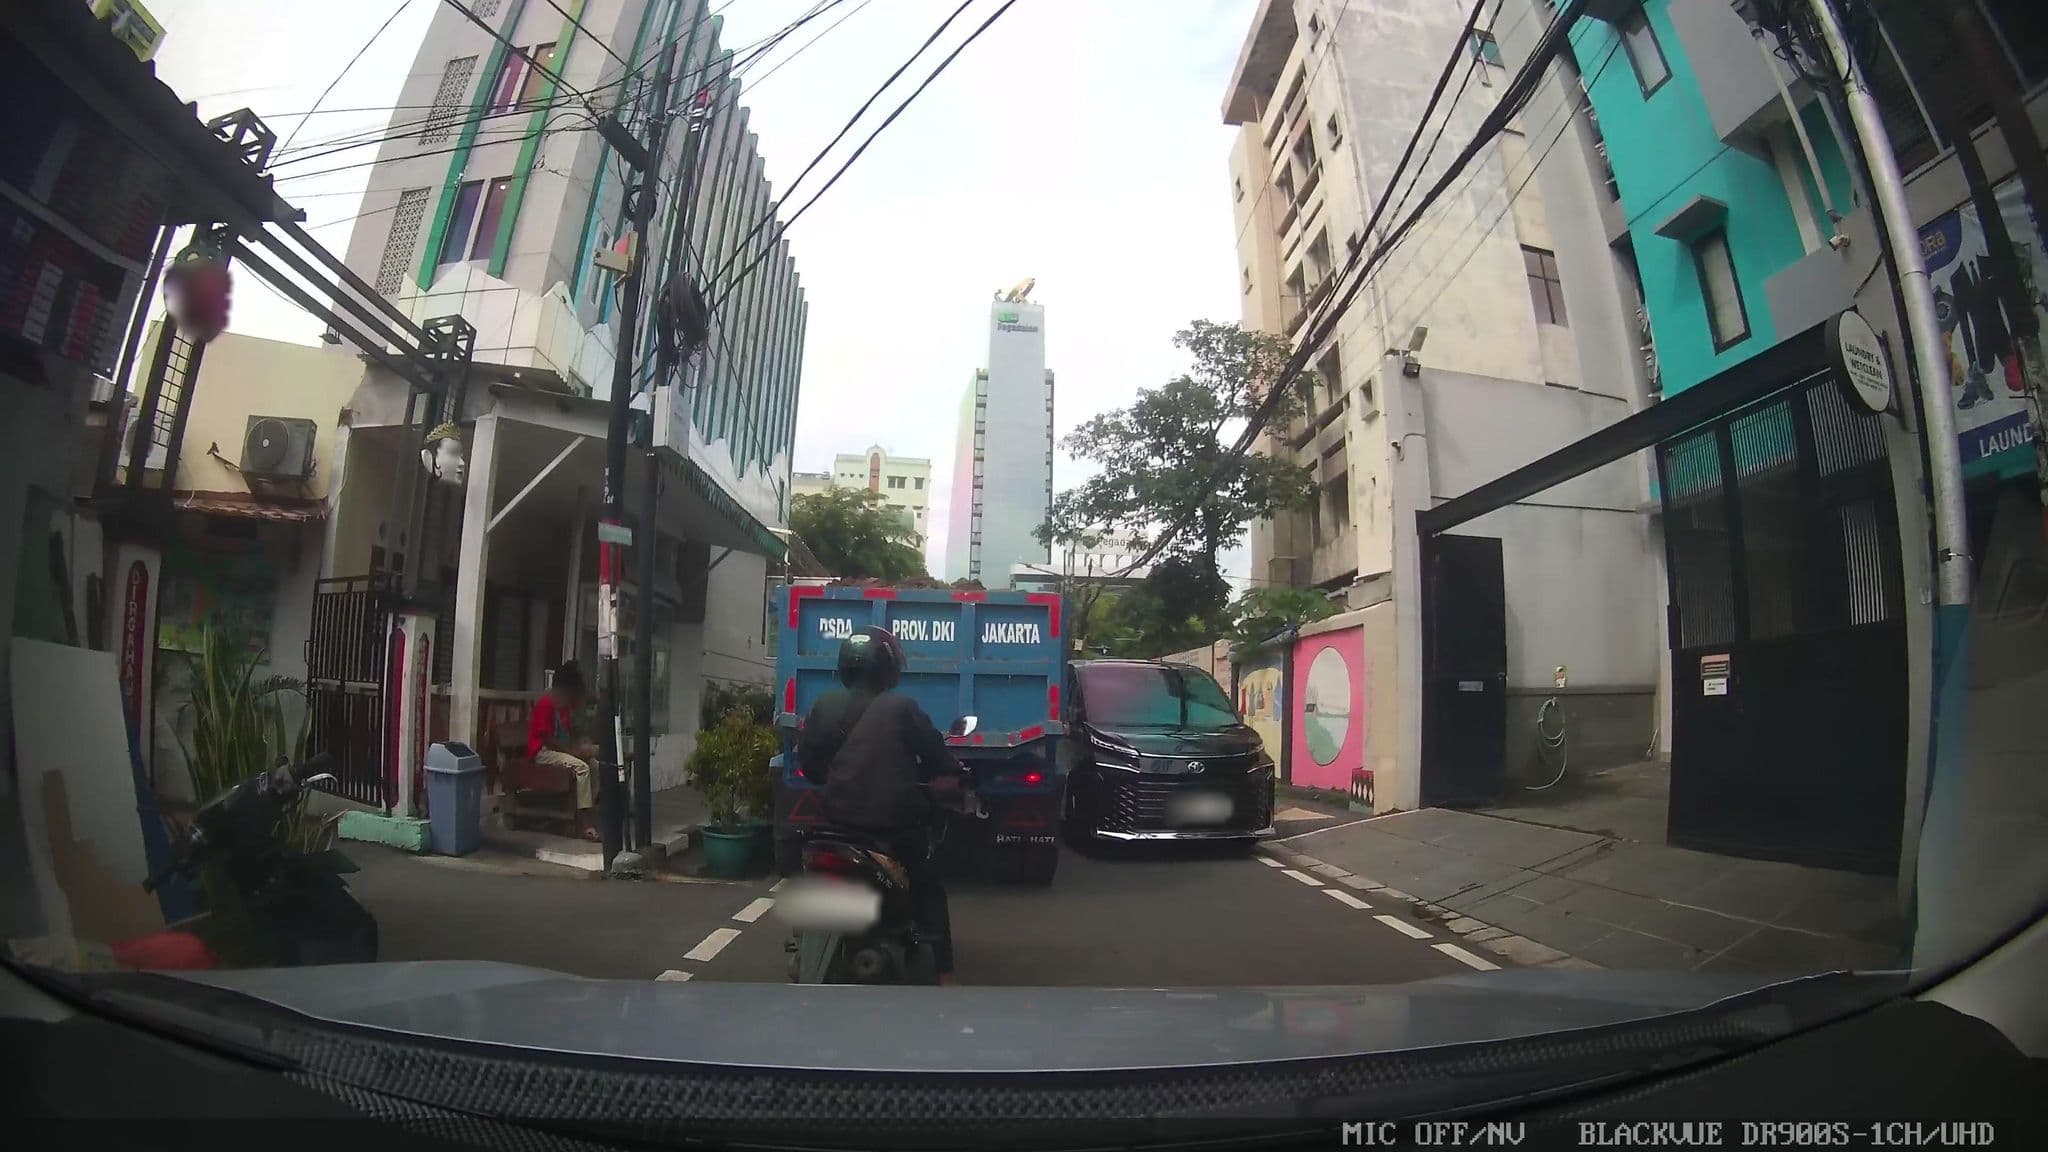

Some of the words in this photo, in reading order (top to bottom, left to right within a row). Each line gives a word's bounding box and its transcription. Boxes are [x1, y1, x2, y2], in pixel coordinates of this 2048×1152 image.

[819, 617, 853, 639] DSDA
[892, 619, 928, 641] PROV.
[932, 621, 955, 642] DKI
[981, 623, 1040, 644] JAKARTA
[1030, 836, 1055, 844] HATI
